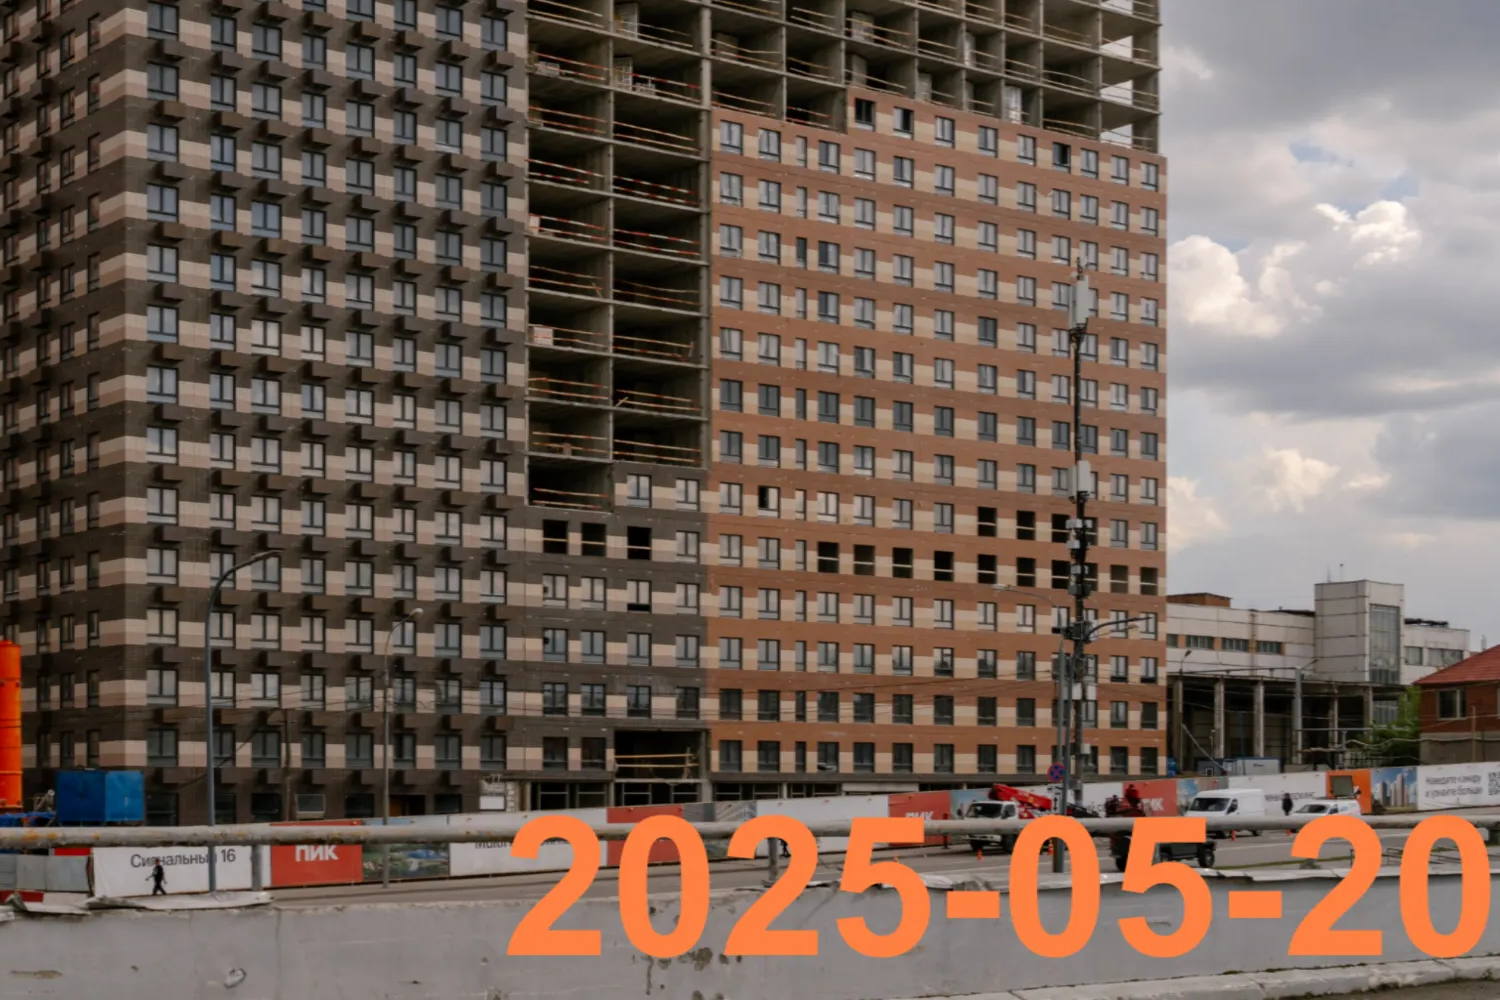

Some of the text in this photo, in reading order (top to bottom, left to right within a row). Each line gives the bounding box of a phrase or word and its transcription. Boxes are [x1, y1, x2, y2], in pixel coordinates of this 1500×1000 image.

[130, 848, 236, 868] Сигнальны 16
[294, 845, 339, 862] ПИК
